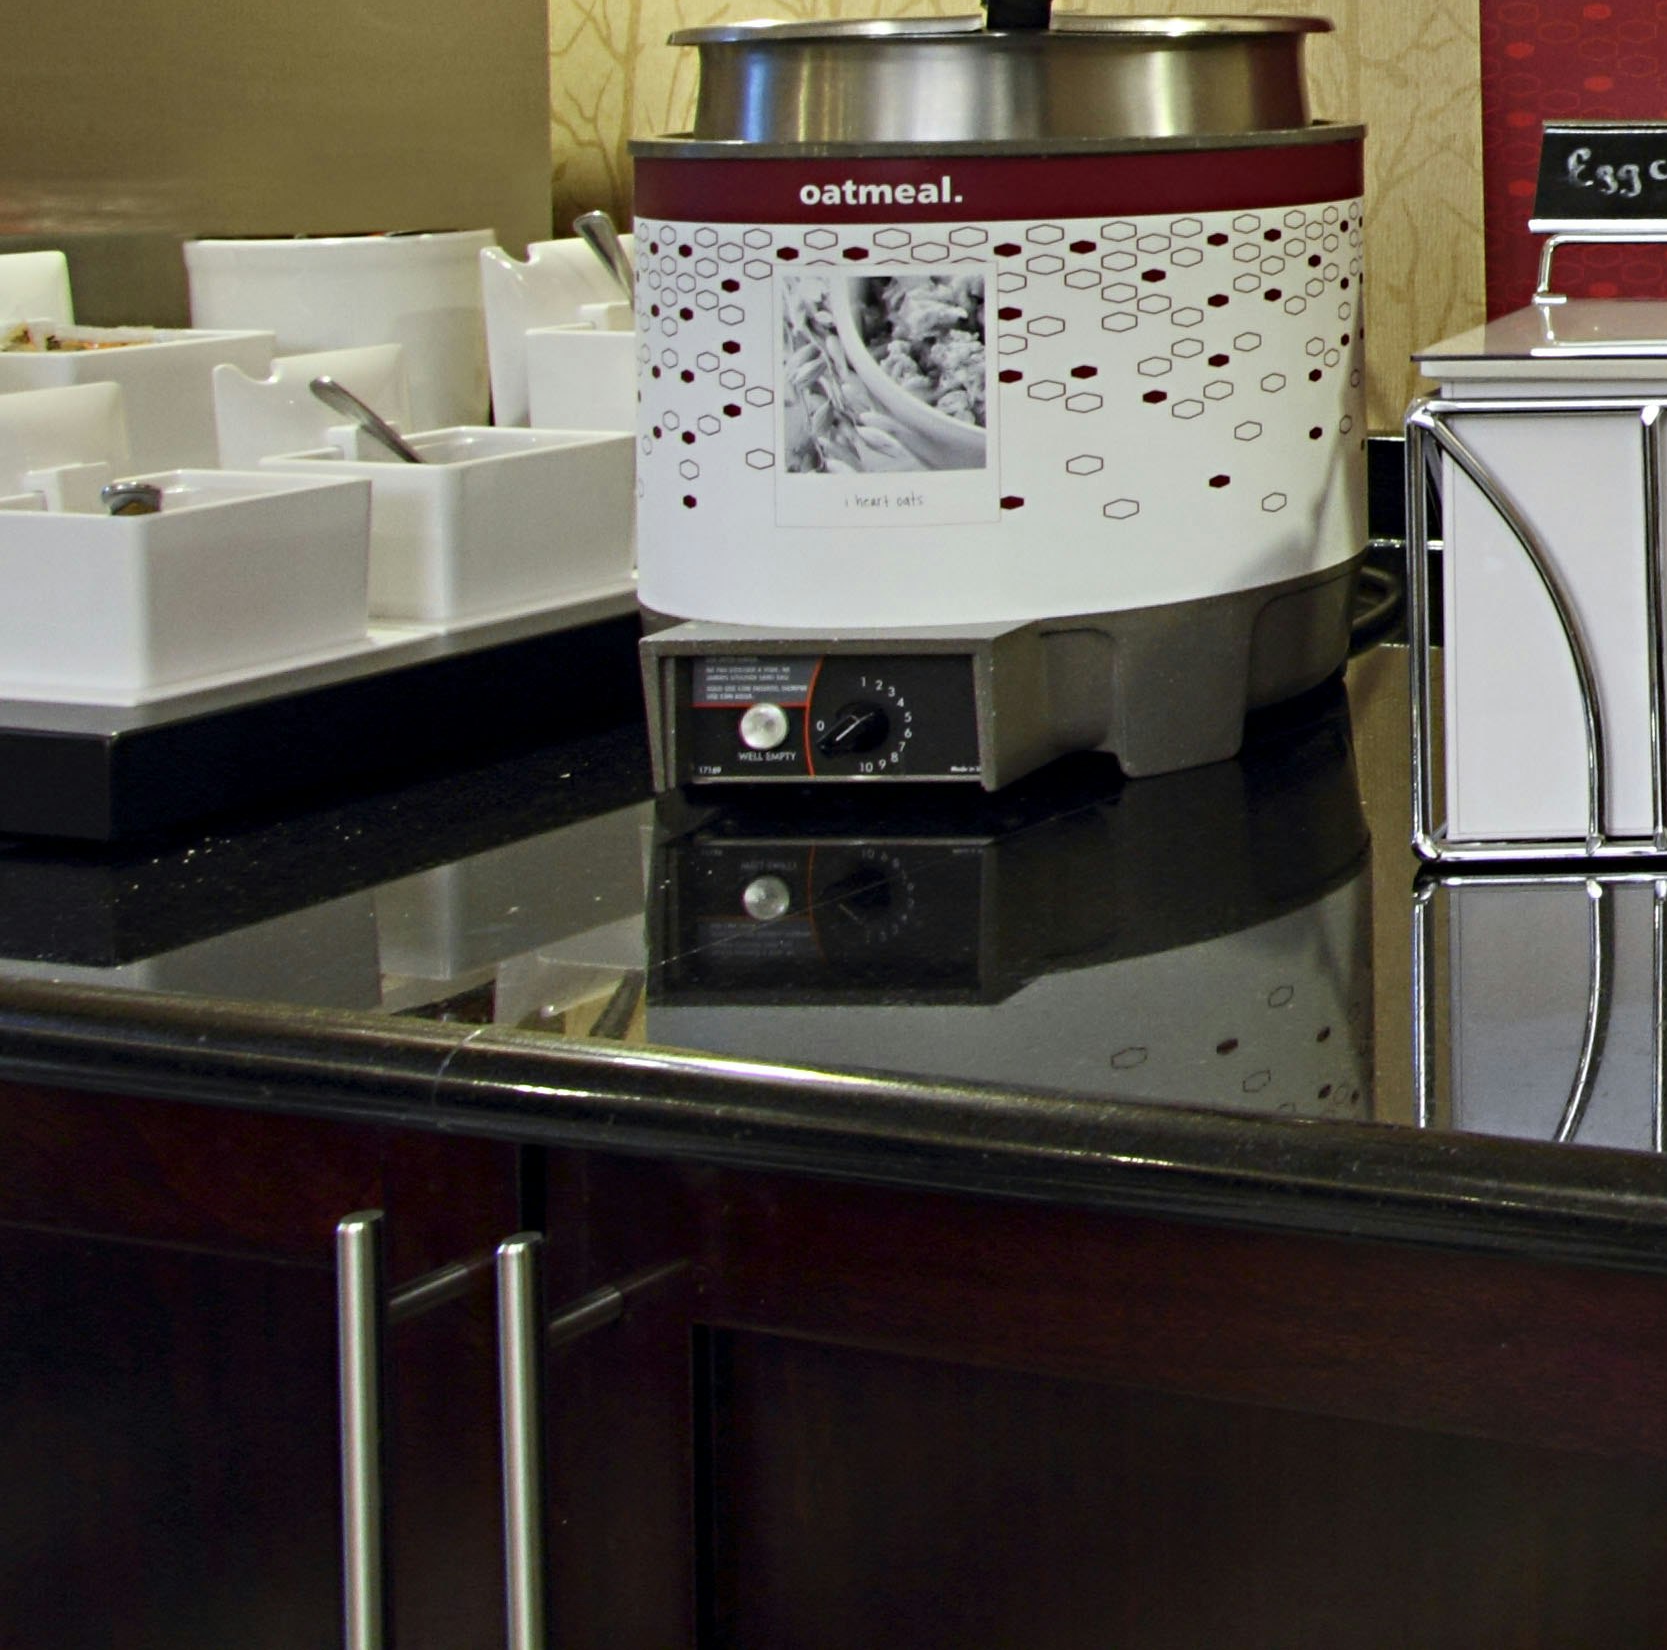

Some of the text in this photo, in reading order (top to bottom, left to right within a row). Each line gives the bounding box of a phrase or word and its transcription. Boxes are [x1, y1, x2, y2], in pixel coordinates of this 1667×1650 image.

[799, 175, 964, 206] oatmeal.
[854, 492, 888, 508] heart
[896, 490, 925, 508] oats
[874, 678, 884, 691] 2
[887, 685, 897, 698] 3
[896, 696, 905, 708] 4
[904, 711, 913, 723] 5
[816, 719, 825, 732] 0
[904, 727, 913, 739] 6
[898, 741, 906, 752] 7
[738, 751, 797, 762] WELL EMPTY
[890, 752, 899, 763] 8
[859, 761, 874, 773] 10
[878, 759, 887, 771] 9
